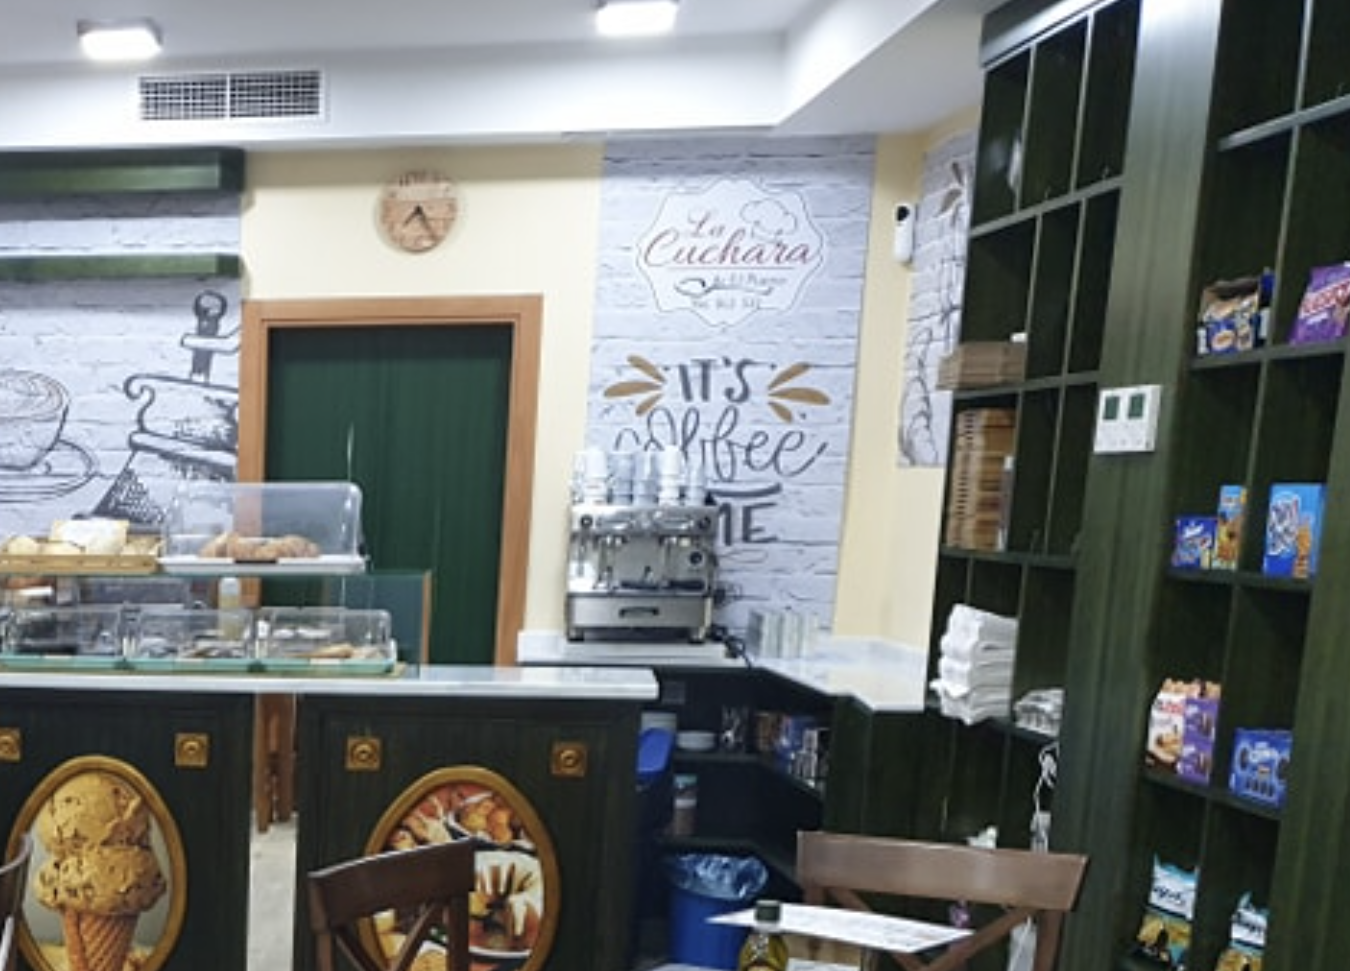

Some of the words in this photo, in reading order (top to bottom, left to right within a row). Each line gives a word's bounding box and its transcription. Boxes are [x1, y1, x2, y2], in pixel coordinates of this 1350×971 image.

[687, 208, 725, 237] La
[644, 226, 816, 267] Cuchara
[678, 356, 756, 403] IT'S
